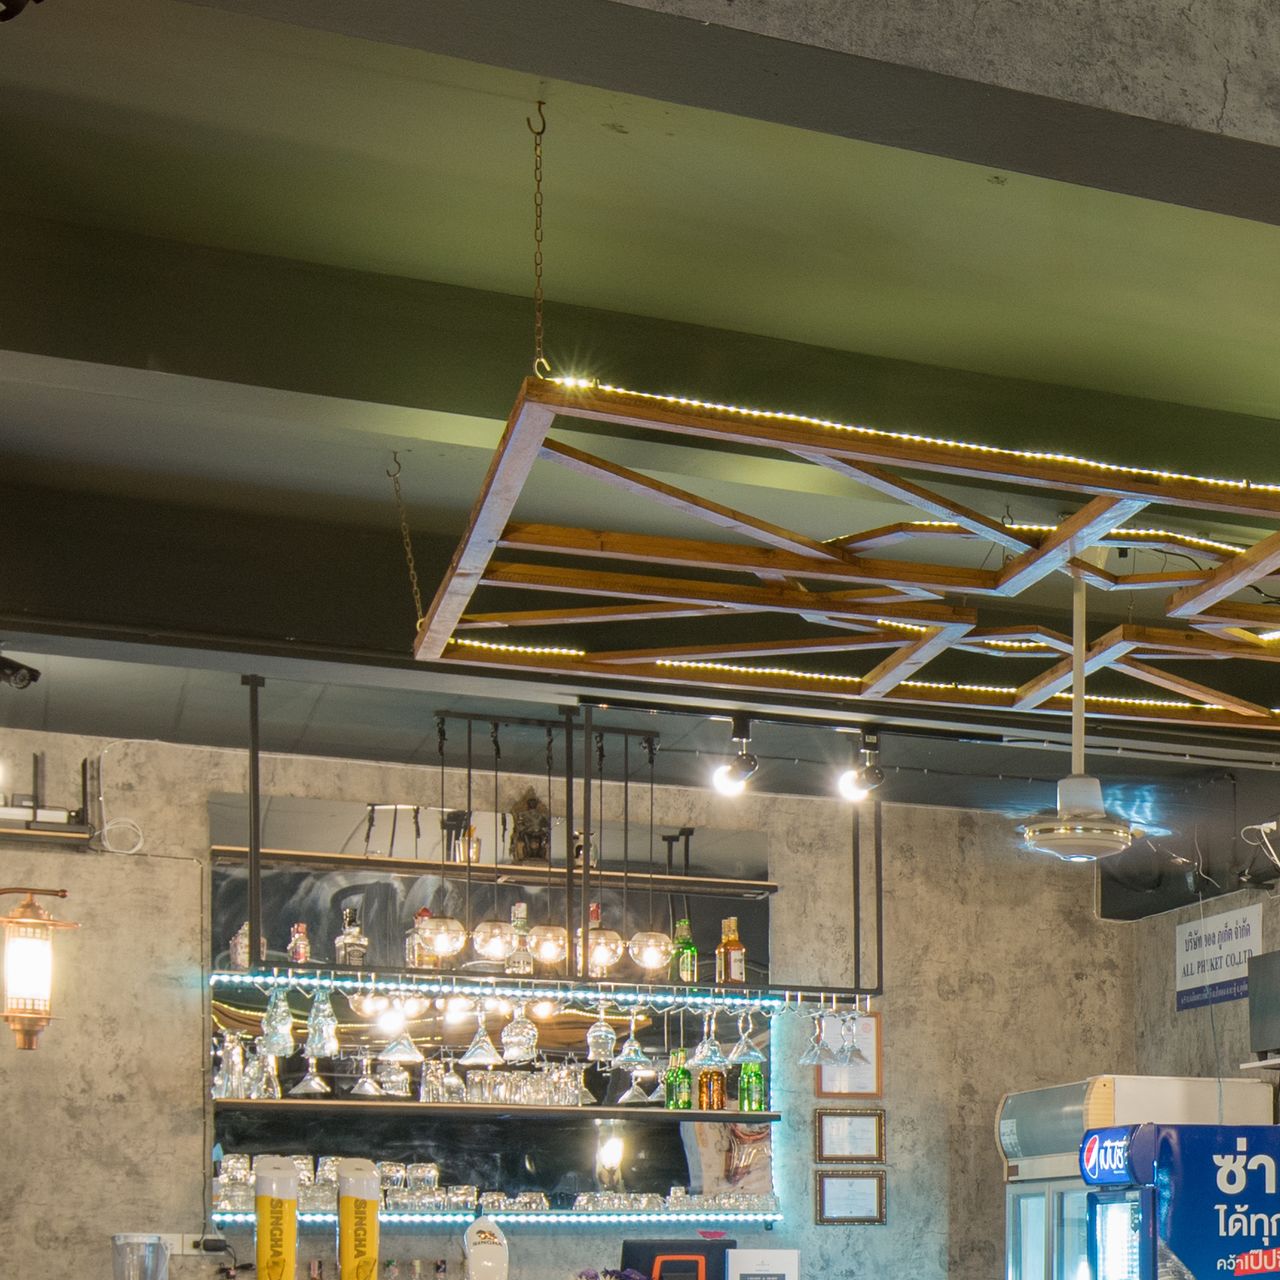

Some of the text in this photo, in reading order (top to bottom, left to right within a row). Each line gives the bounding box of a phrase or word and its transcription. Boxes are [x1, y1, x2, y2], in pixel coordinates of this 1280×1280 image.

[1182, 962, 1195, 977] ALL
[269, 1198, 284, 1259] SINGHA
[353, 1198, 368, 1259] SINGHA
